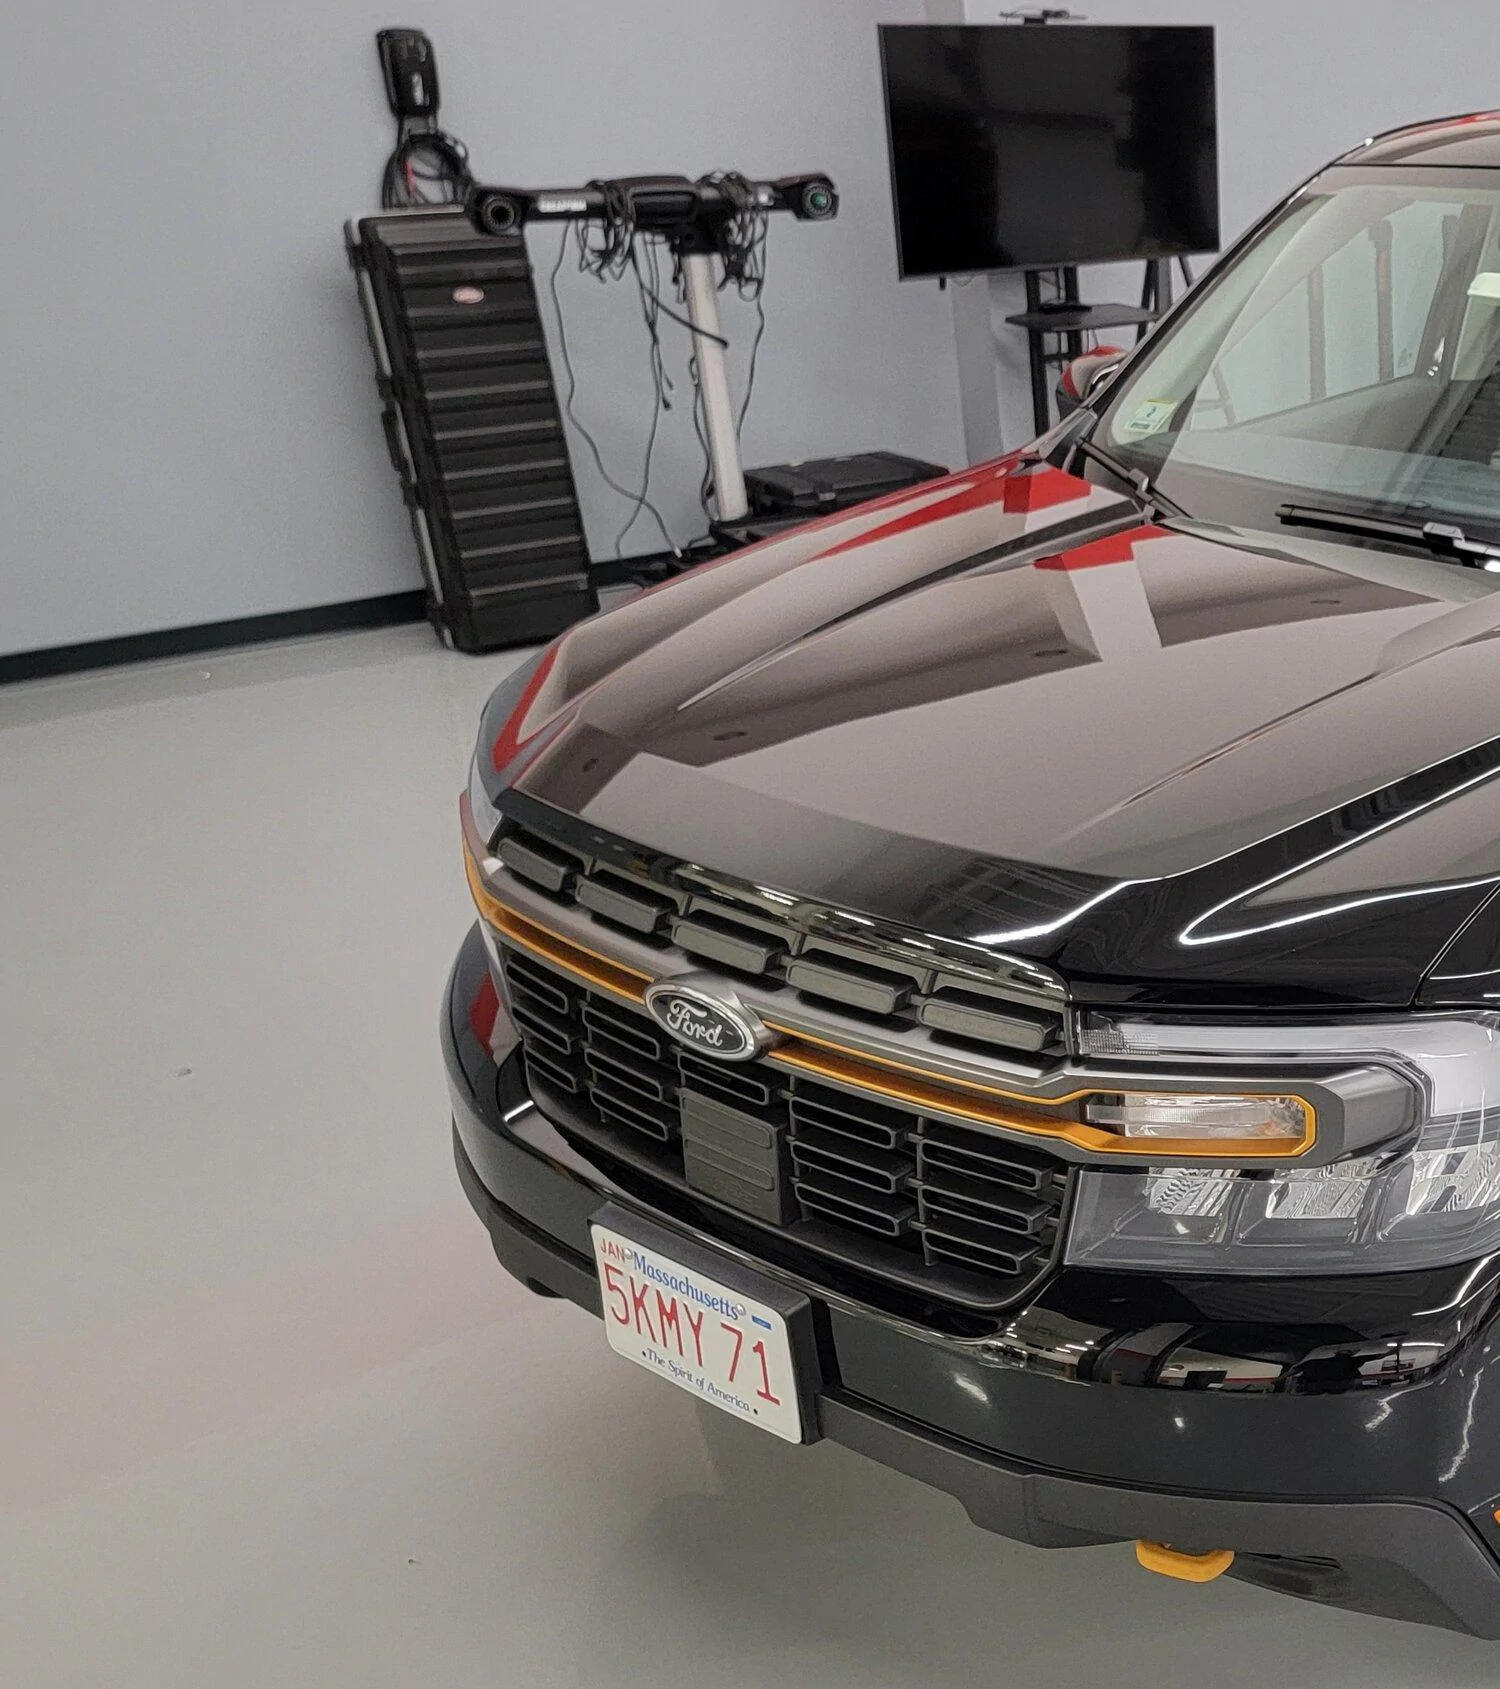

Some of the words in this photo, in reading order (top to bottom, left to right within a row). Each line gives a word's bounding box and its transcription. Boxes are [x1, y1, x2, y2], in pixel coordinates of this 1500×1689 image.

[667, 999, 723, 1046] Ford
[600, 1238, 625, 1263] JAN
[633, 1251, 738, 1320] Massachusetts
[604, 1262, 703, 1368] 5KMY
[720, 1322, 780, 1406] 71
[647, 1347, 666, 1368] The
[668, 1360, 693, 1383] Spirit
[695, 1377, 705, 1391] of
[707, 1382, 750, 1412] America
